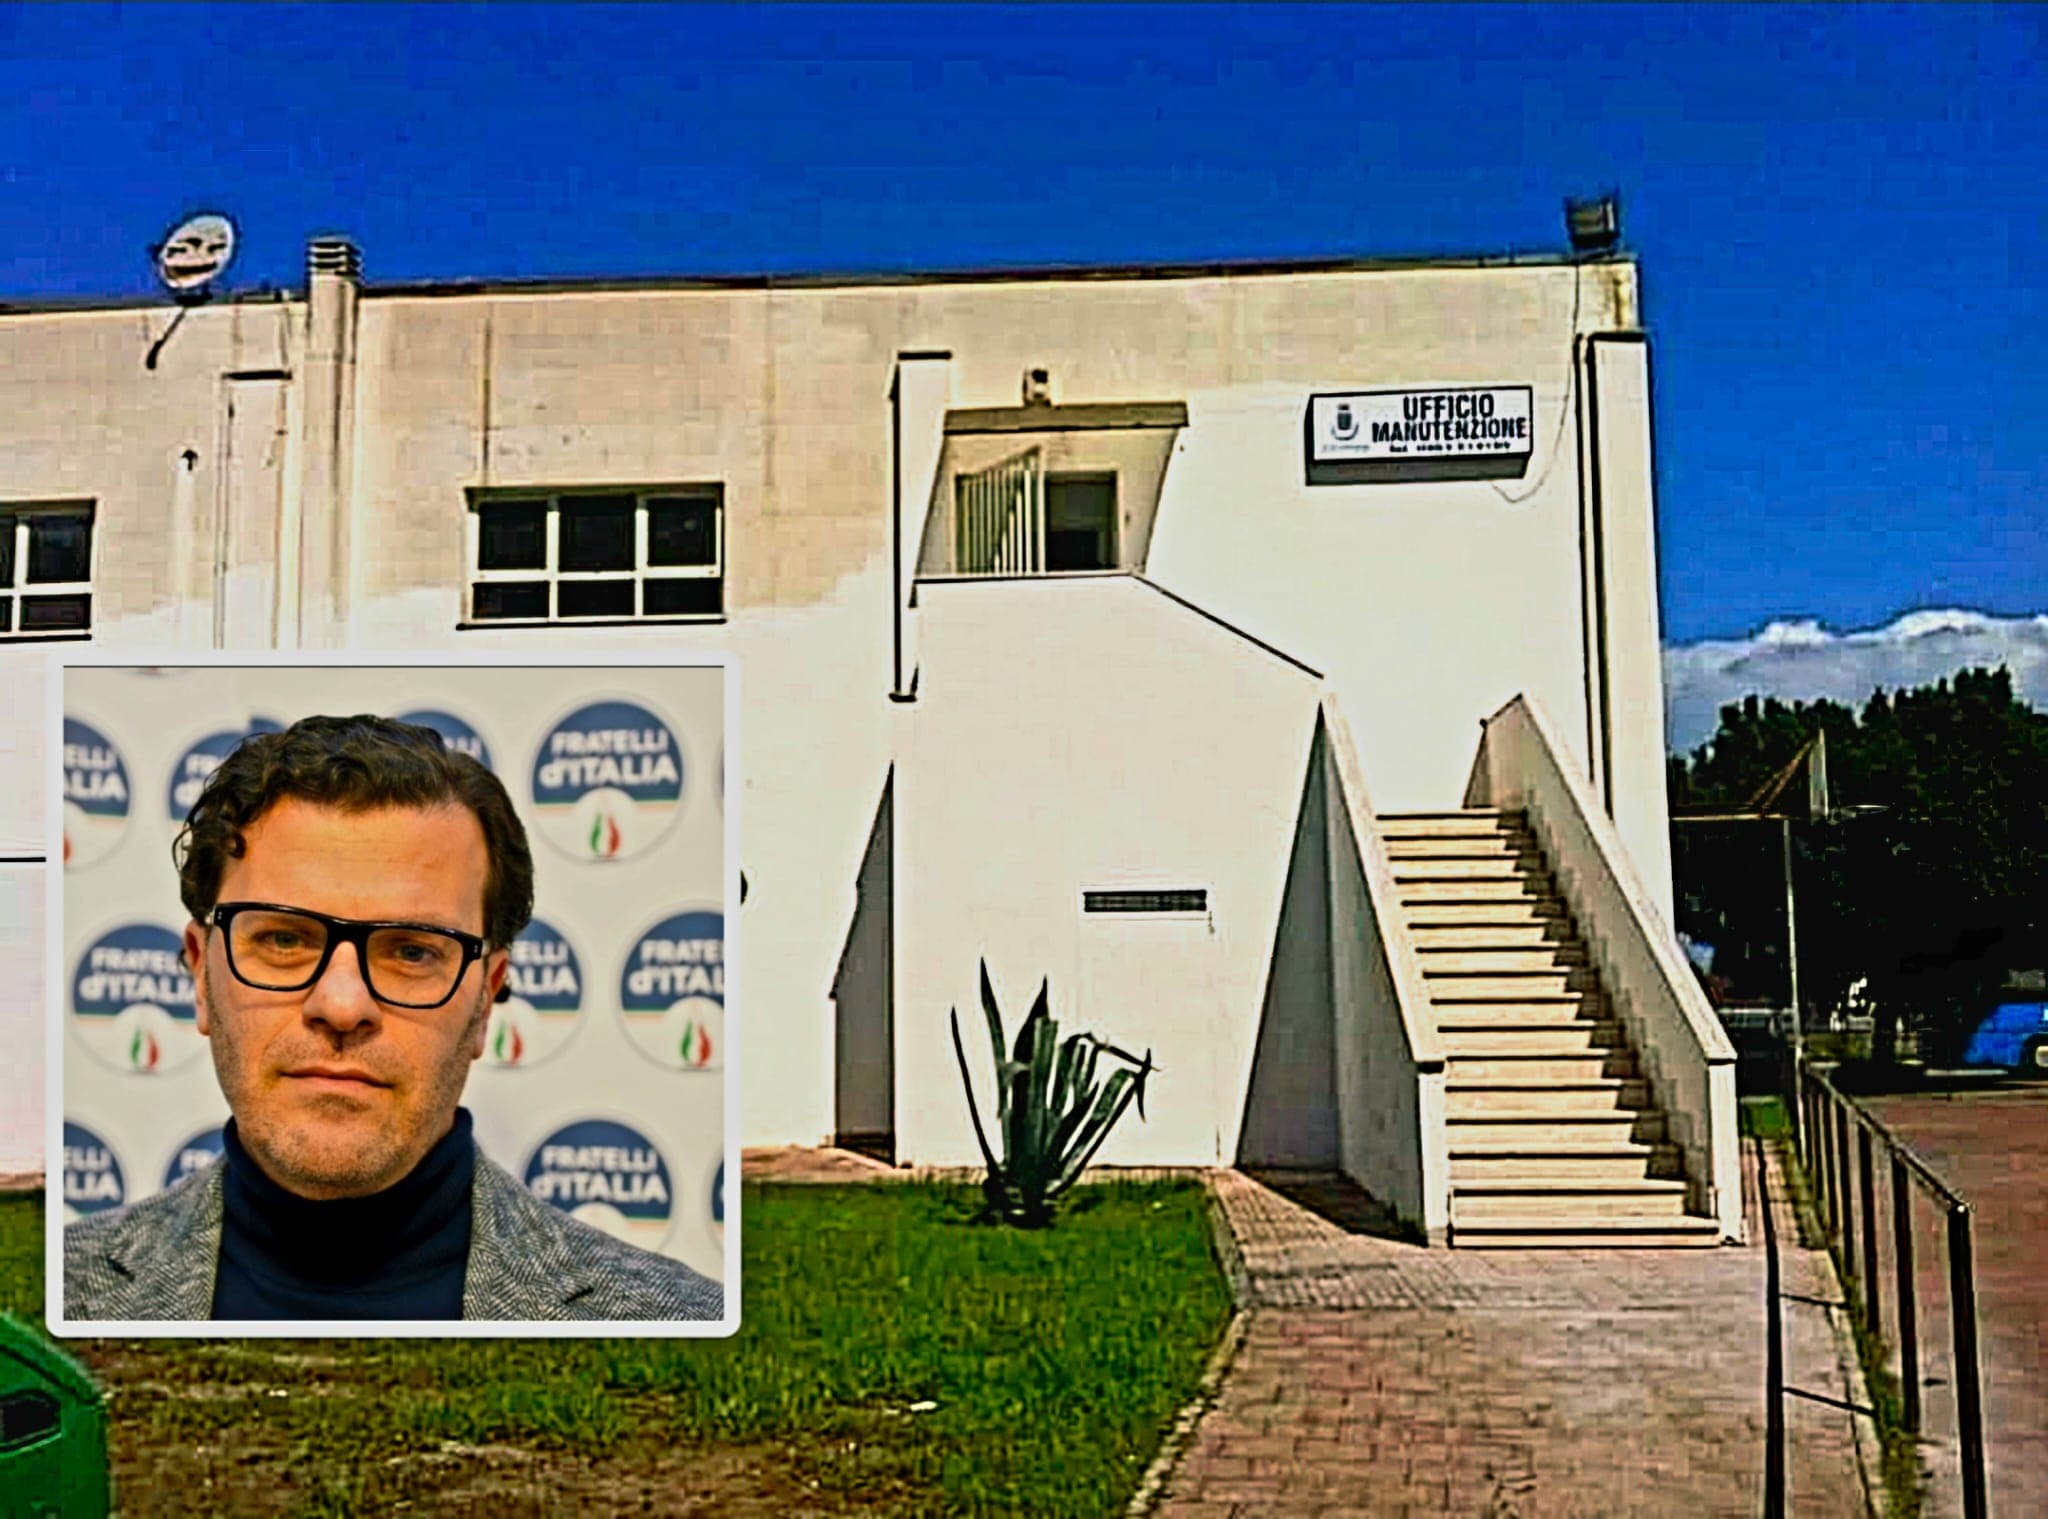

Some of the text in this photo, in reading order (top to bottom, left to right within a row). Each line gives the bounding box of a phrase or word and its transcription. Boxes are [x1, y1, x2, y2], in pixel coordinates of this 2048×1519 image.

[1403, 393, 1495, 420] UFFICIO
[1371, 417, 1527, 442] MANUTENZIONE
[551, 729, 669, 754] FRATELLI
[64, 743, 117, 770] ELLI
[507, 964, 579, 996] ALIA
[541, 1145, 658, 1171] FRATELLI
